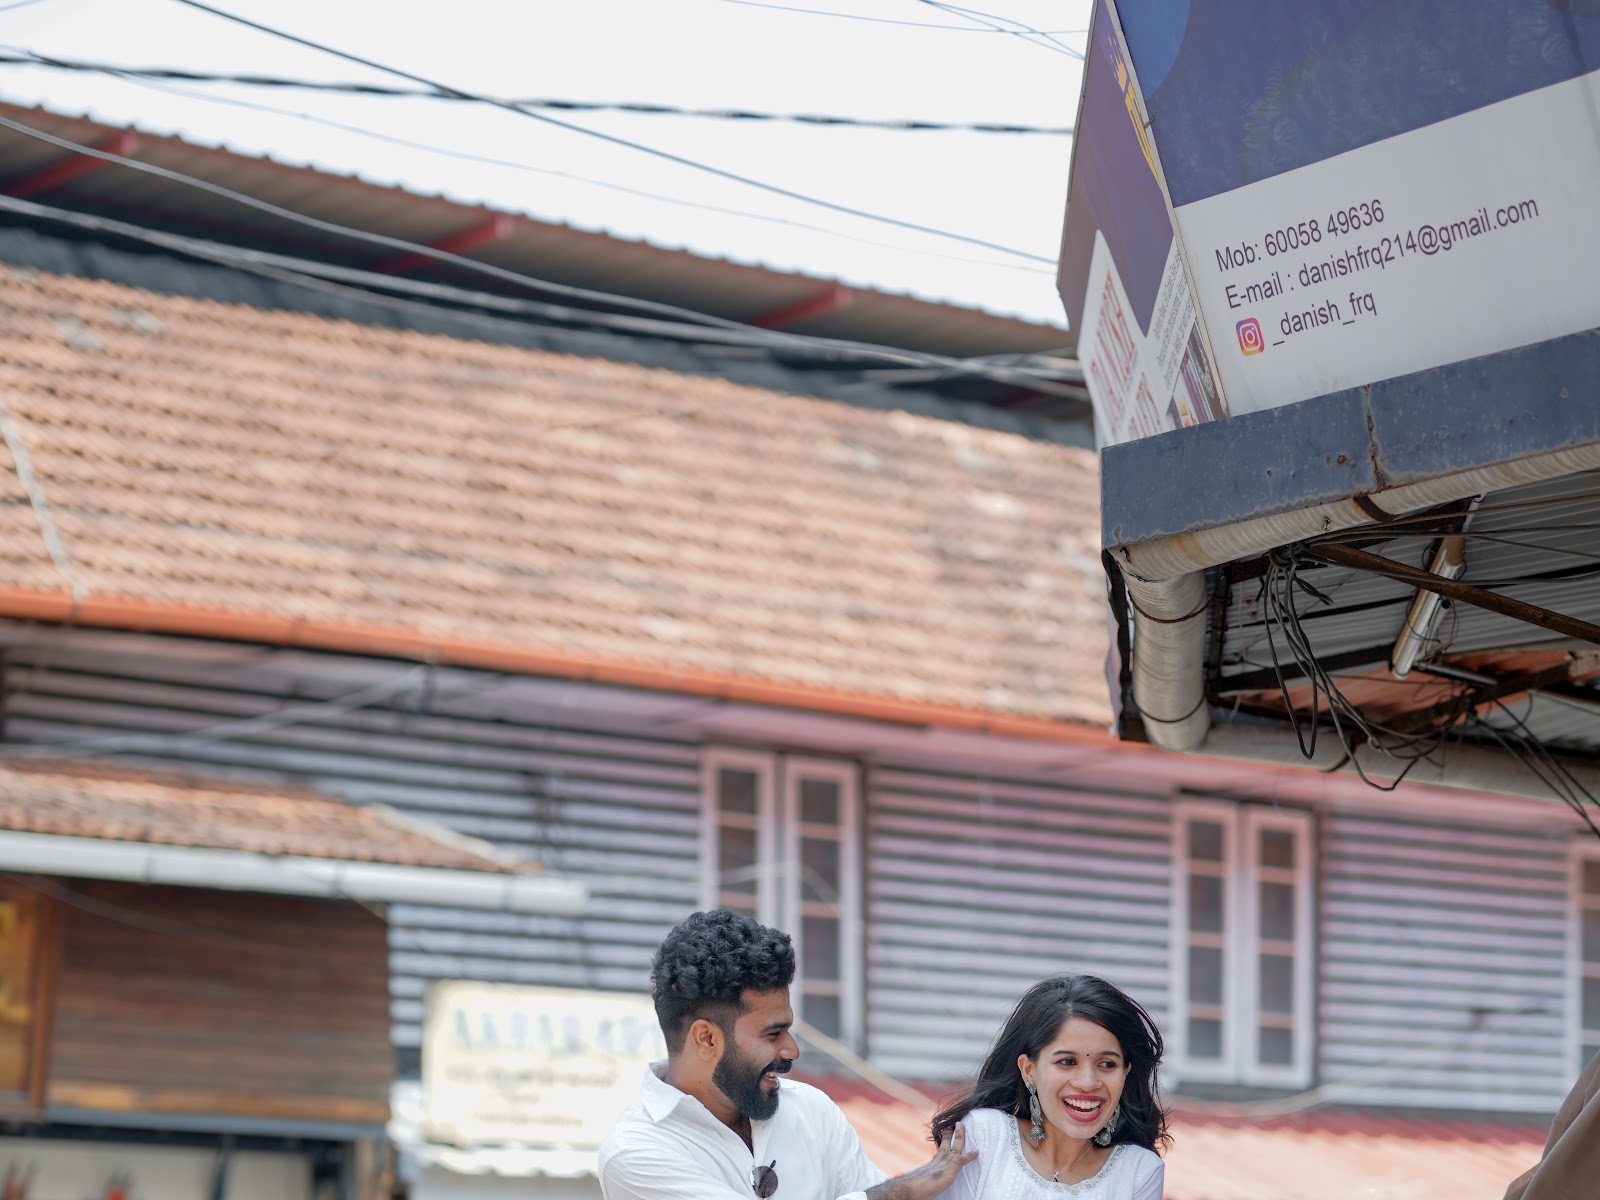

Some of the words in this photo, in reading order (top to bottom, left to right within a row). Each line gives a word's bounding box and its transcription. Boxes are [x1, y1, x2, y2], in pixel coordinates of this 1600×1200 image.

[1214, 240, 1263, 273] Mob:
[1264, 219, 1323, 257] 60058
[1327, 198, 1386, 237] 49636
[1224, 271, 1284, 310] E-mail
[1298, 198, 1540, 289] danishfrq214@gmail.com
[1272, 291, 1379, 348] _danish_frq
